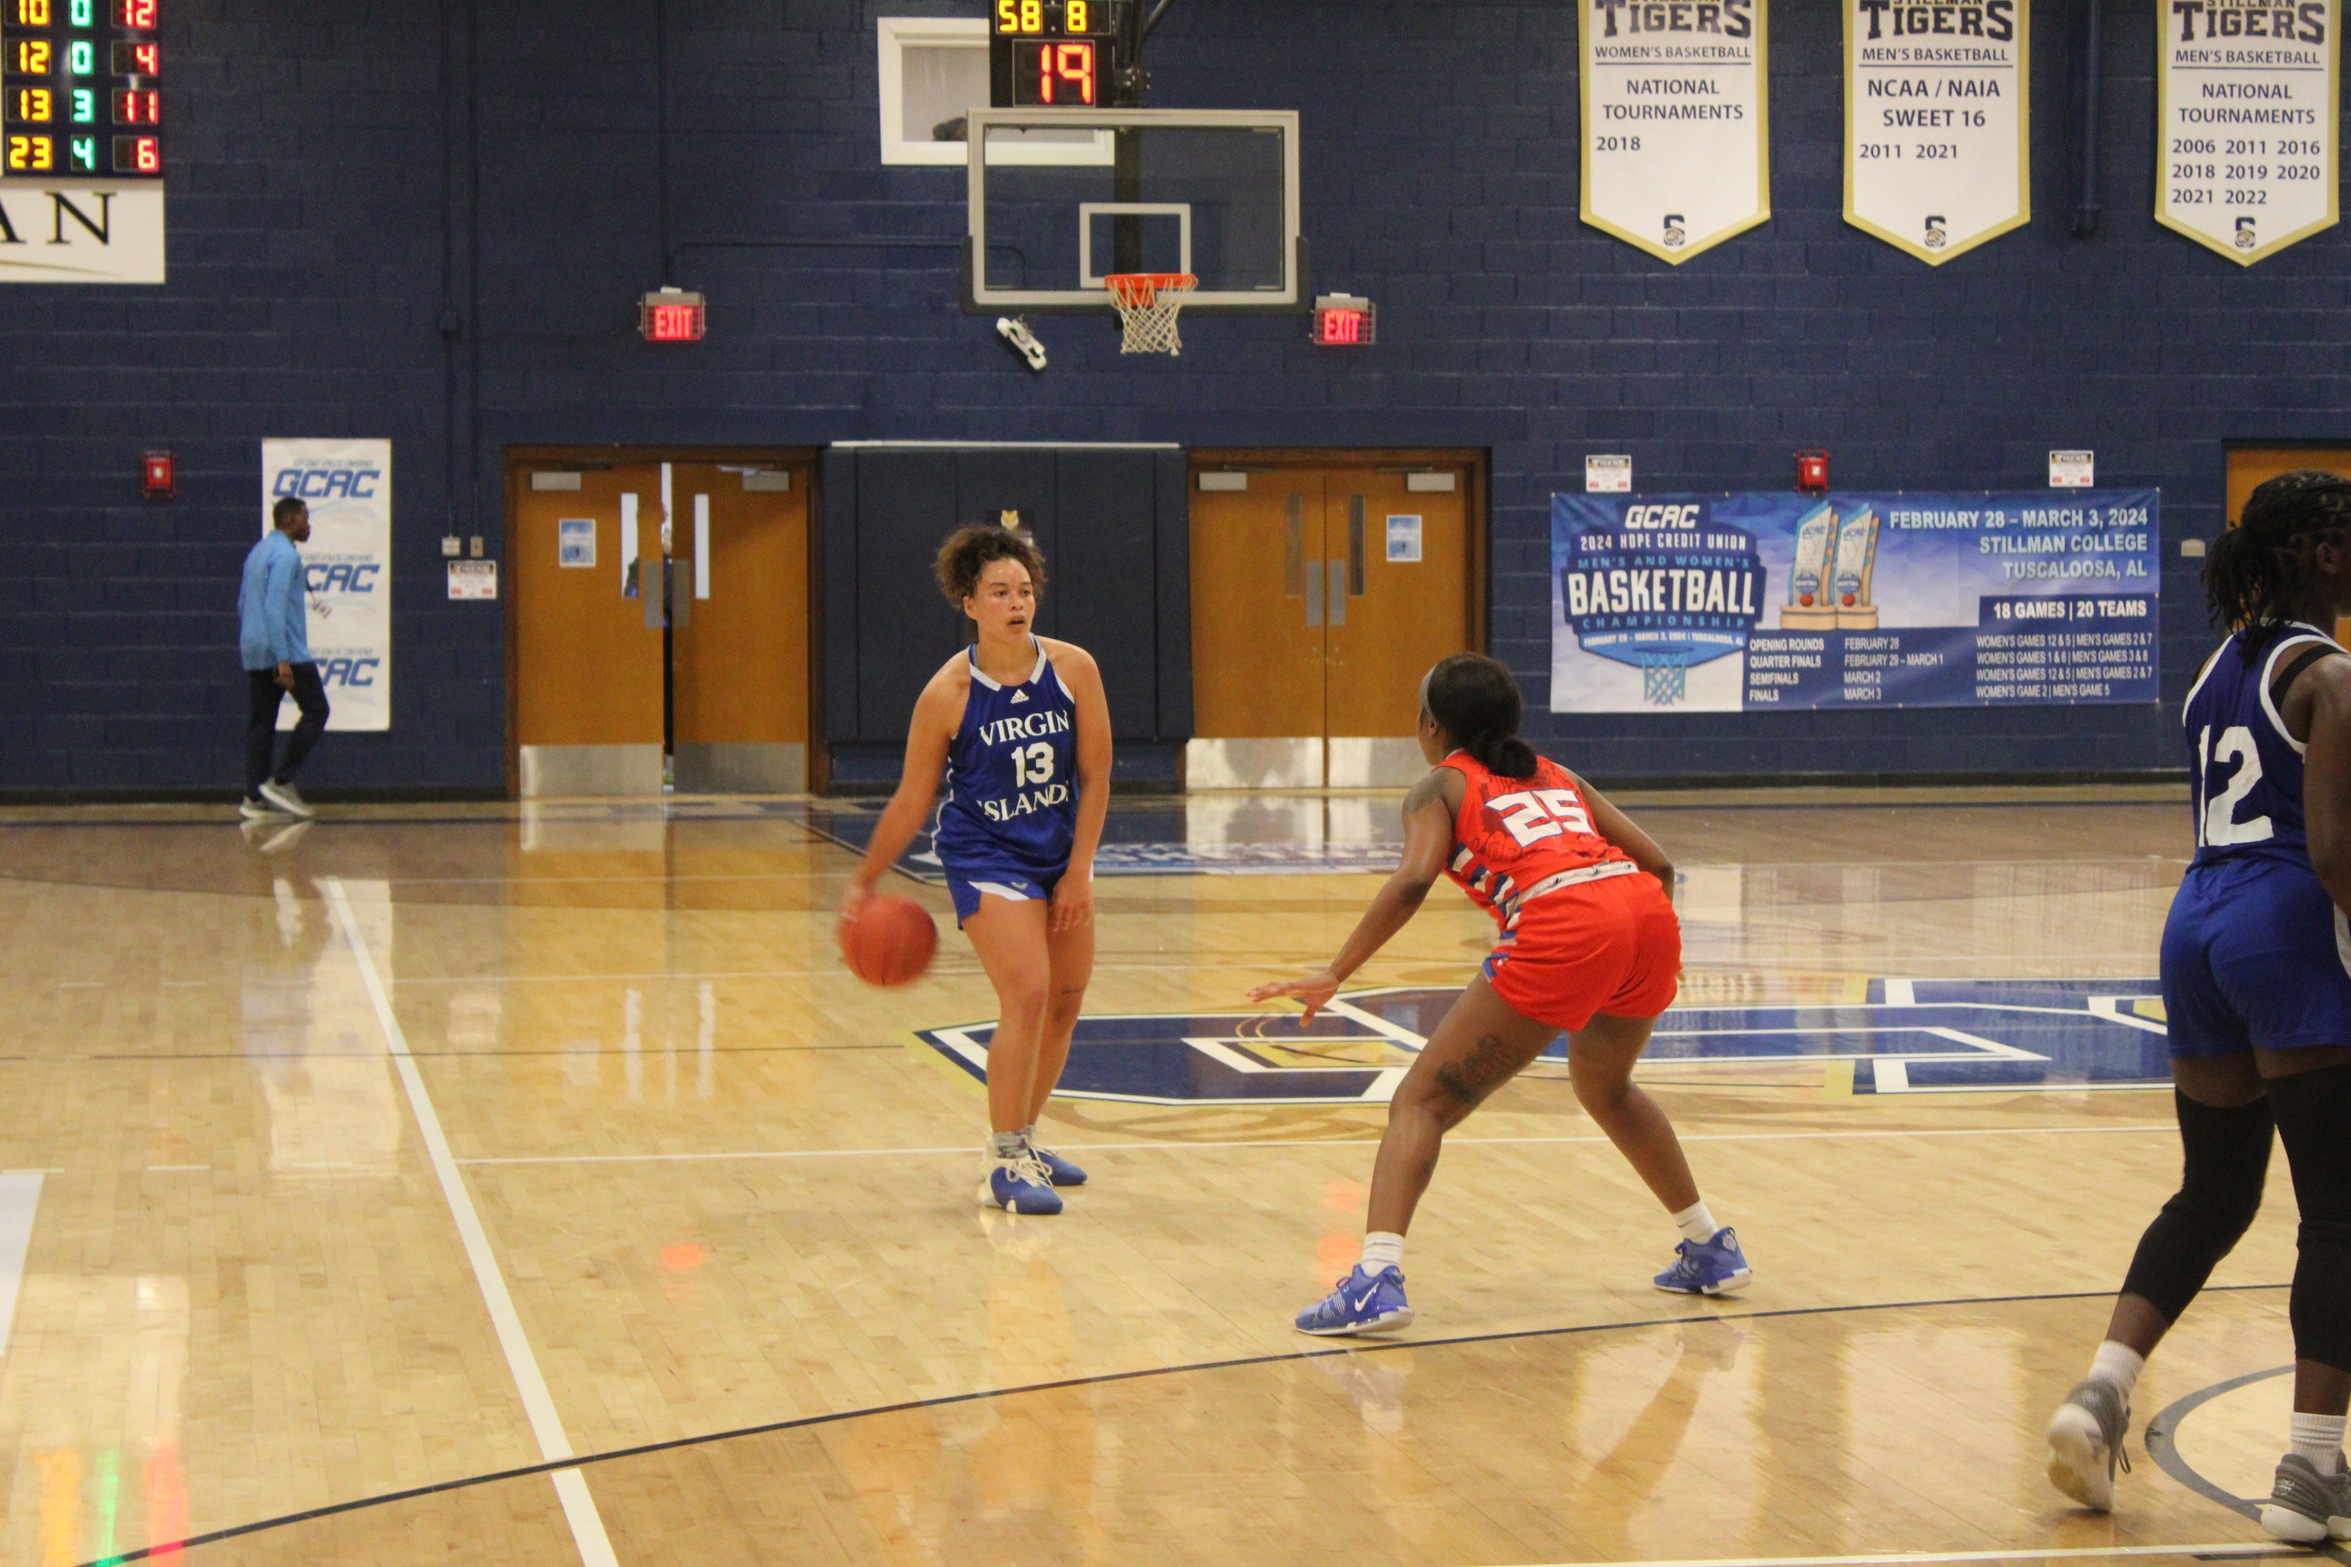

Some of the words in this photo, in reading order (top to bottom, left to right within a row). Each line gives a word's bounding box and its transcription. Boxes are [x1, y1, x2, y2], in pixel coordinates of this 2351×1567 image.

[18, 0, 50, 25] 10
[70, 0, 94, 26] 0
[125, 0, 155, 28] 12
[998, 0, 1041, 32] 58
[1067, 0, 1087, 32] 8
[1594, 0, 1752, 39] TIGERS
[1859, 0, 2013, 42] TIGERS
[2173, 1, 2325, 45] TIGERS
[19, 40, 49, 73] 12
[71, 40, 93, 75] 0
[135, 44, 157, 75] 4
[1595, 46, 1662, 58] WOMEN'S
[1665, 46, 1752, 58] BASKETBALL
[1862, 48, 1910, 61] MEN'S
[1914, 49, 2009, 61] BASKETBALL
[2175, 50, 2222, 62] MEN'S
[2226, 51, 2320, 64] BASKETBALL
[1041, 43, 1092, 104] 19
[1626, 79, 1720, 95] NATIONAL
[1867, 79, 1930, 98] NCAA
[1948, 79, 2001, 97] NAIA
[2202, 84, 2293, 99] NATIONAL
[20, 89, 51, 121] 13
[73, 89, 93, 122] 3
[127, 91, 158, 123] 11
[1602, 104, 1744, 120] TOURNAMENTS
[1882, 110, 1954, 127] SWEET
[1962, 110, 1986, 127] 16
[2179, 108, 2316, 124] TOURNAMENTS
[1596, 136, 1641, 151] 2018
[1859, 144, 1902, 159] 2011
[1915, 145, 1959, 159] 2021
[2172, 139, 2216, 154] 2006
[2225, 140, 2267, 154] 2011
[2277, 141, 2321, 155] 2016
[9, 136, 51, 169] 23
[73, 137, 94, 170] 4
[137, 138, 158, 170] 6
[2172, 164, 2216, 179] 2018
[2225, 165, 2268, 179] 2019
[2277, 166, 2320, 180] 2020
[2172, 189, 2214, 204] 2021
[2224, 190, 2267, 204] 2022
[655, 307, 693, 338] EXIT
[1324, 311, 1361, 342] EXIT
[1625, 505, 1699, 529] GCAC
[1890, 511, 1980, 529] FEBRUARY
[1985, 511, 2005, 527] 28
[2023, 510, 2083, 527] MARCH
[2089, 510, 2104, 529] 3,
[2109, 508, 2148, 526] 2024
[1581, 535, 1613, 551] 2024
[1620, 533, 1651, 549] HOPE
[1657, 533, 1701, 548] CREDIT
[1708, 534, 1746, 550] UNION
[1980, 536, 2065, 554] STILLMAN
[2071, 534, 2148, 551] COLLEGE
[1634, 556, 1667, 567] AND
[303, 563, 380, 592] CAC
[2003, 561, 2121, 580] TUSCALOOSA,
[2126, 560, 2148, 577] AL
[1568, 569, 1756, 616] BASKETBALL
[1994, 602, 2011, 619] 18
[2015, 601, 2065, 619] GAMES
[2077, 601, 2094, 617] 20
[2098, 600, 2147, 617] TEAMS
[1582, 616, 1745, 630] CHAMPIONSHIP
[1750, 639, 1787, 651] OPENING
[1789, 638, 1824, 651] ROUNDS
[1845, 637, 1888, 650] FEBRUARY
[2017, 634, 2045, 648] GAMES
[2102, 633, 2131, 646] GAMES
[1750, 655, 1790, 668] QUARTER
[1792, 655, 1821, 668] FINALS
[1845, 654, 1888, 667] FEBRUARY
[1907, 653, 1937, 666] MARCH
[2017, 652, 2045, 664] GAMES
[2098, 650, 2127, 663] GAMES
[1750, 673, 1799, 685] SEMIFINALS
[1844, 671, 1874, 684] MARCH
[2017, 668, 2045, 681] GAMES
[2102, 667, 2131, 680] GAMES
[1750, 689, 1779, 702] FINALS
[1844, 688, 1874, 701] MARCH
[2017, 685, 2040, 698] GAME
[2079, 684, 2103, 697] GAME
[979, 709, 1070, 747] VIRGIN
[1011, 741, 1055, 788] 13
[2198, 724, 2275, 848] 12
[977, 780, 1068, 821] SLAND
[1484, 787, 1598, 848] 25
